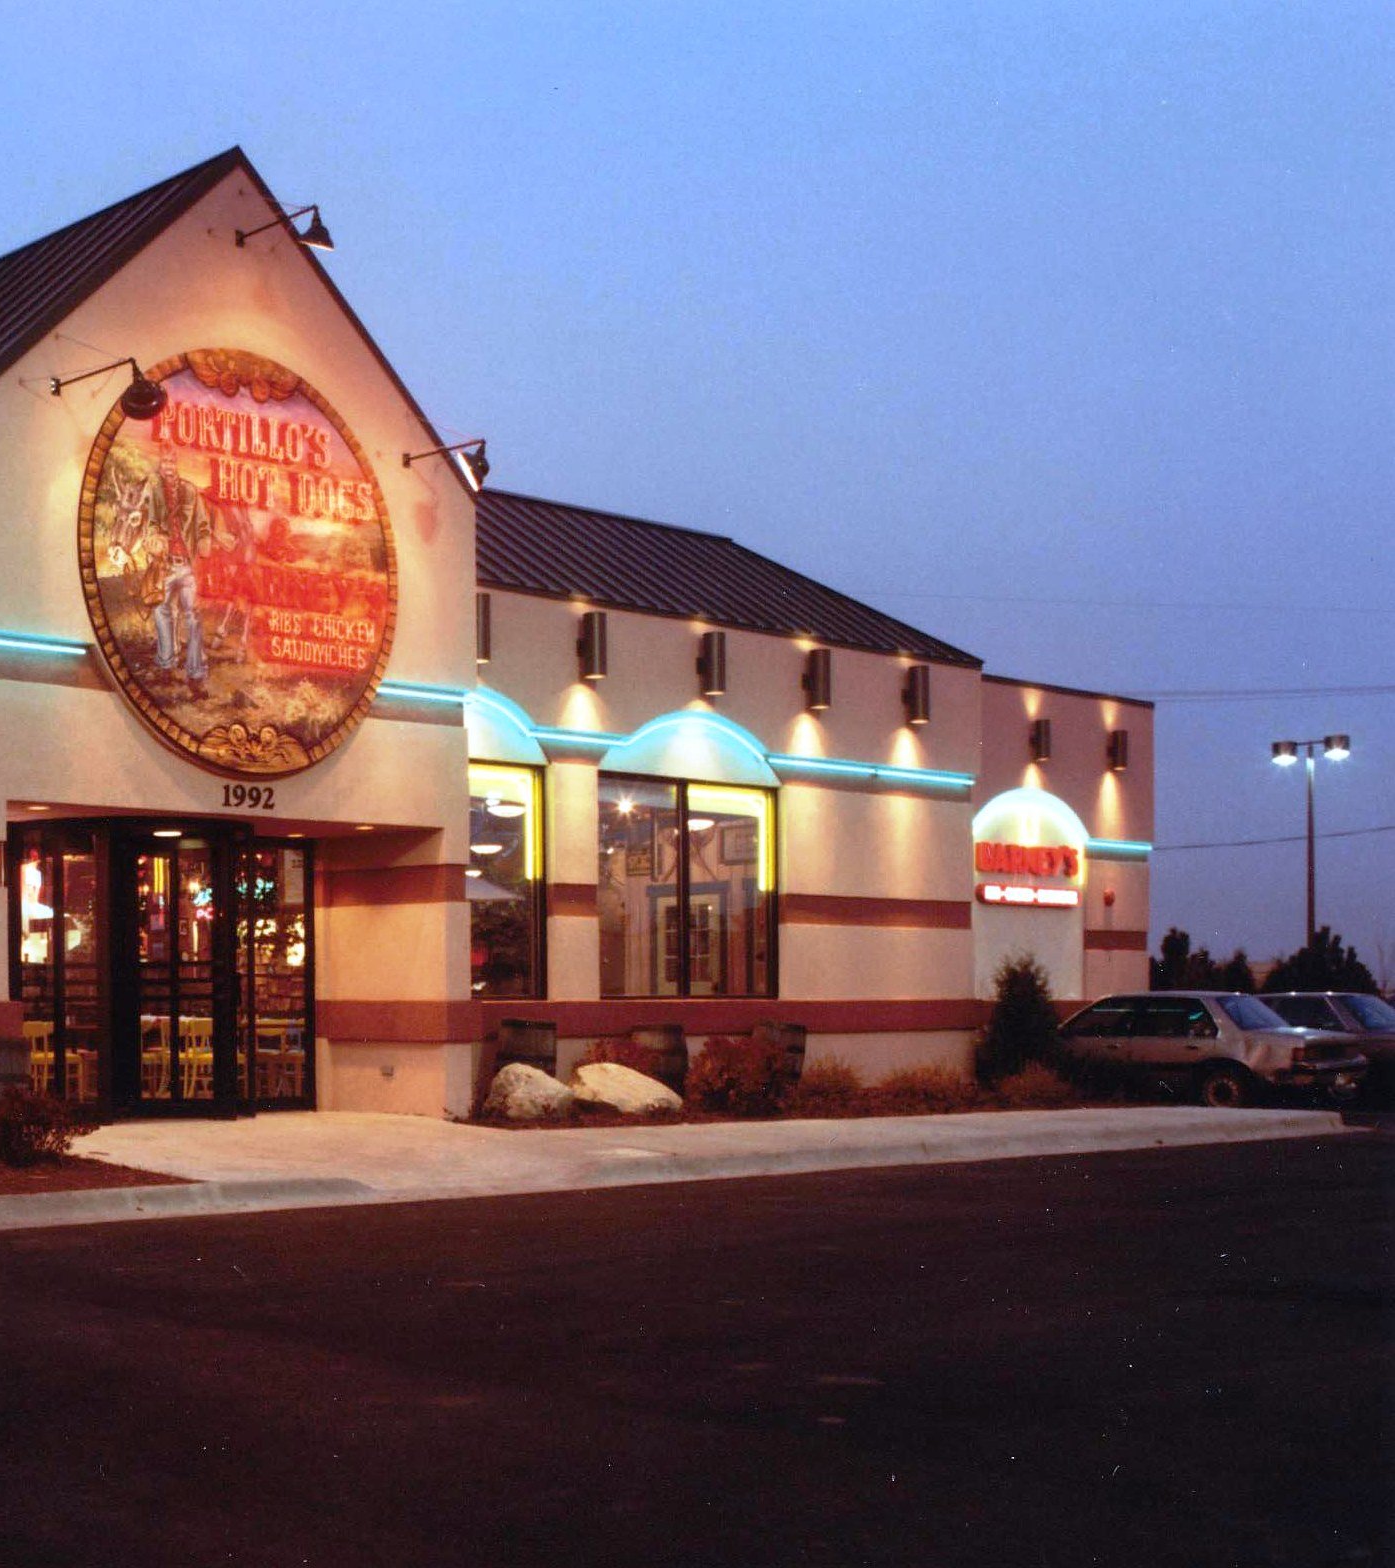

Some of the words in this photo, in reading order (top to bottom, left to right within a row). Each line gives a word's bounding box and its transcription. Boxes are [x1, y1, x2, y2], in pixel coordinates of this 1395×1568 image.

[158, 399, 333, 468] PORTILLO'S
[217, 456, 279, 508] HOT
[297, 473, 374, 521] DOGS
[269, 610, 302, 634] RIBS
[312, 615, 376, 643] CHICKEN
[271, 636, 367, 670] SANDWICHES
[222, 784, 275, 810] 1992
